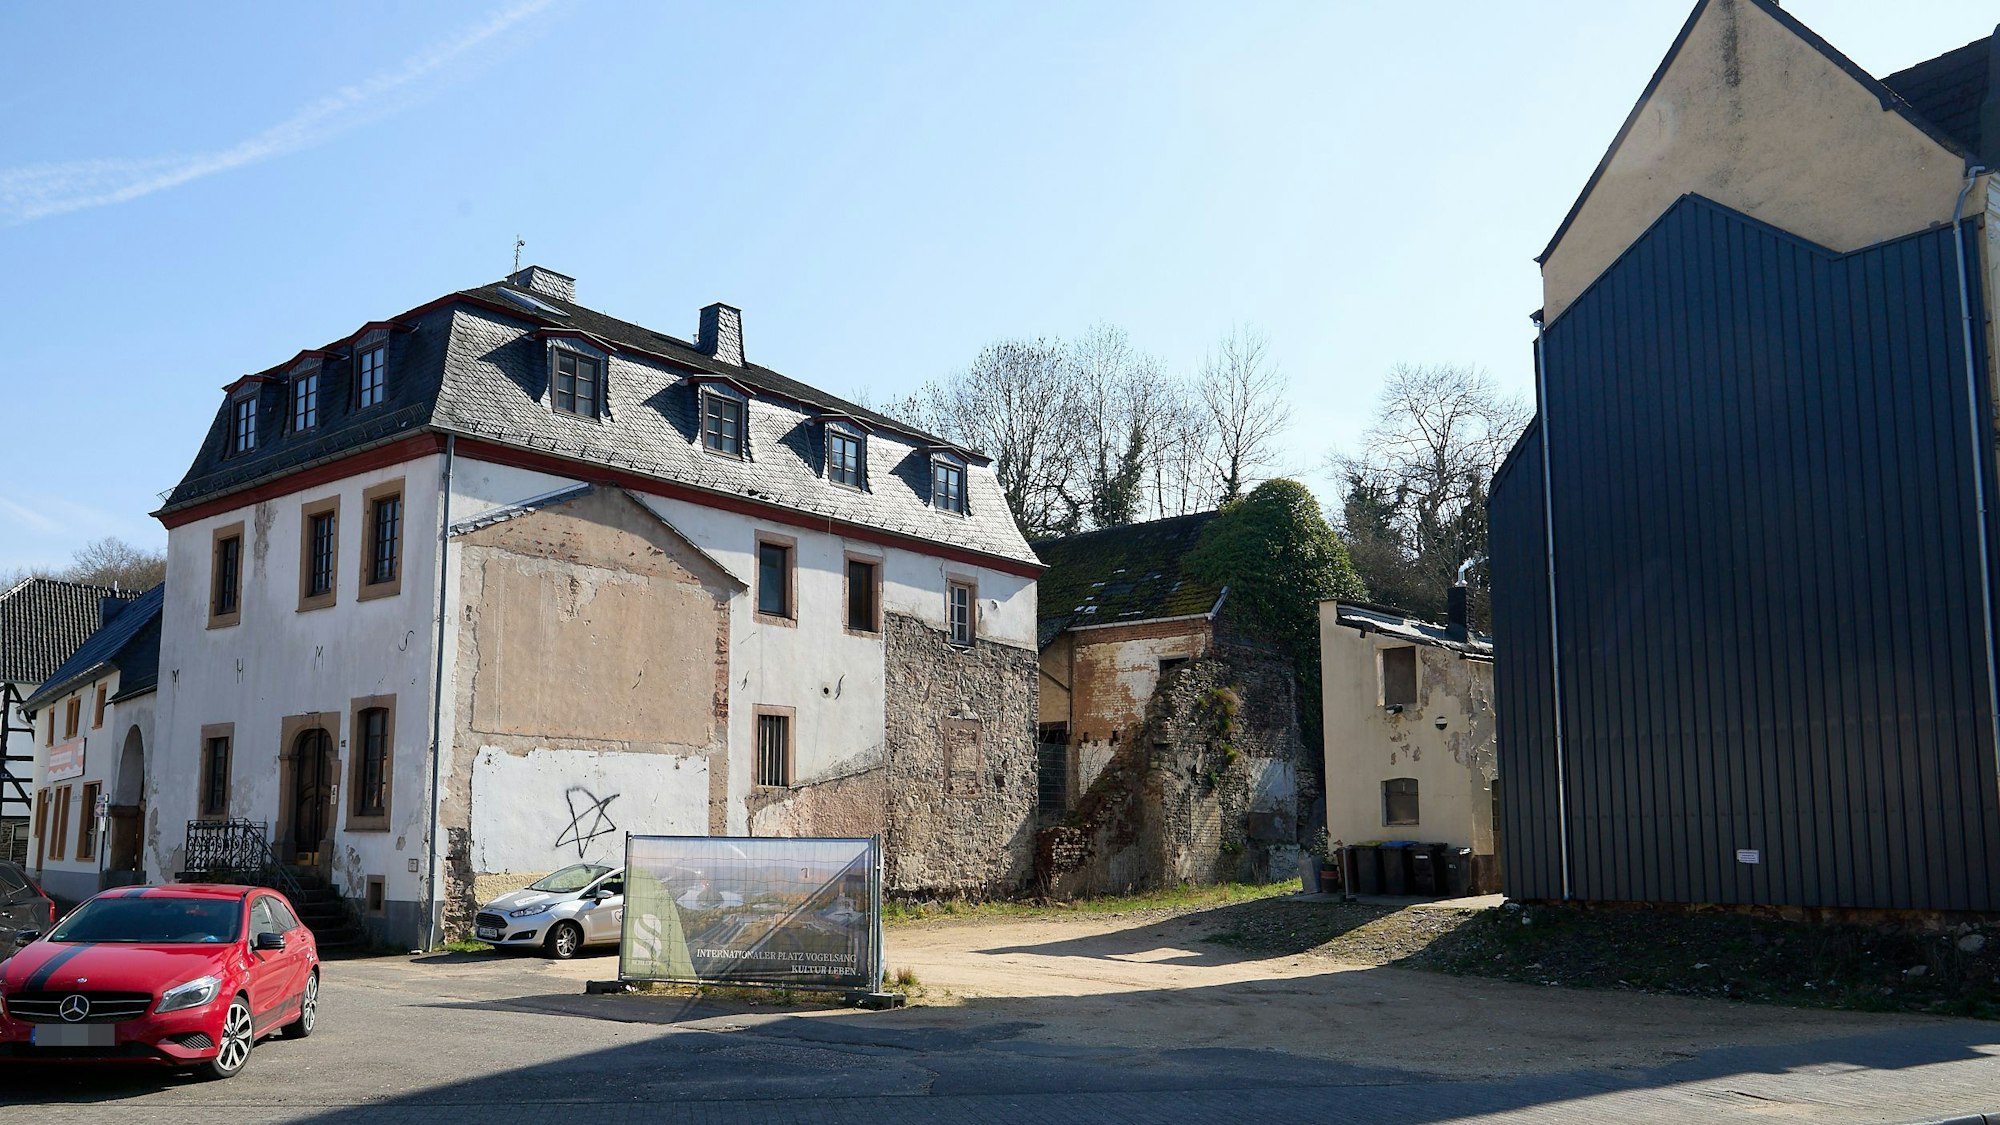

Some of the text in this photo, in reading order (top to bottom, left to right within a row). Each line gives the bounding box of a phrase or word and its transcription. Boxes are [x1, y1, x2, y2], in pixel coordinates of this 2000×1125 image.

[696, 948, 857, 963] INTERNATIONALER PLATZ VOGELSANG
